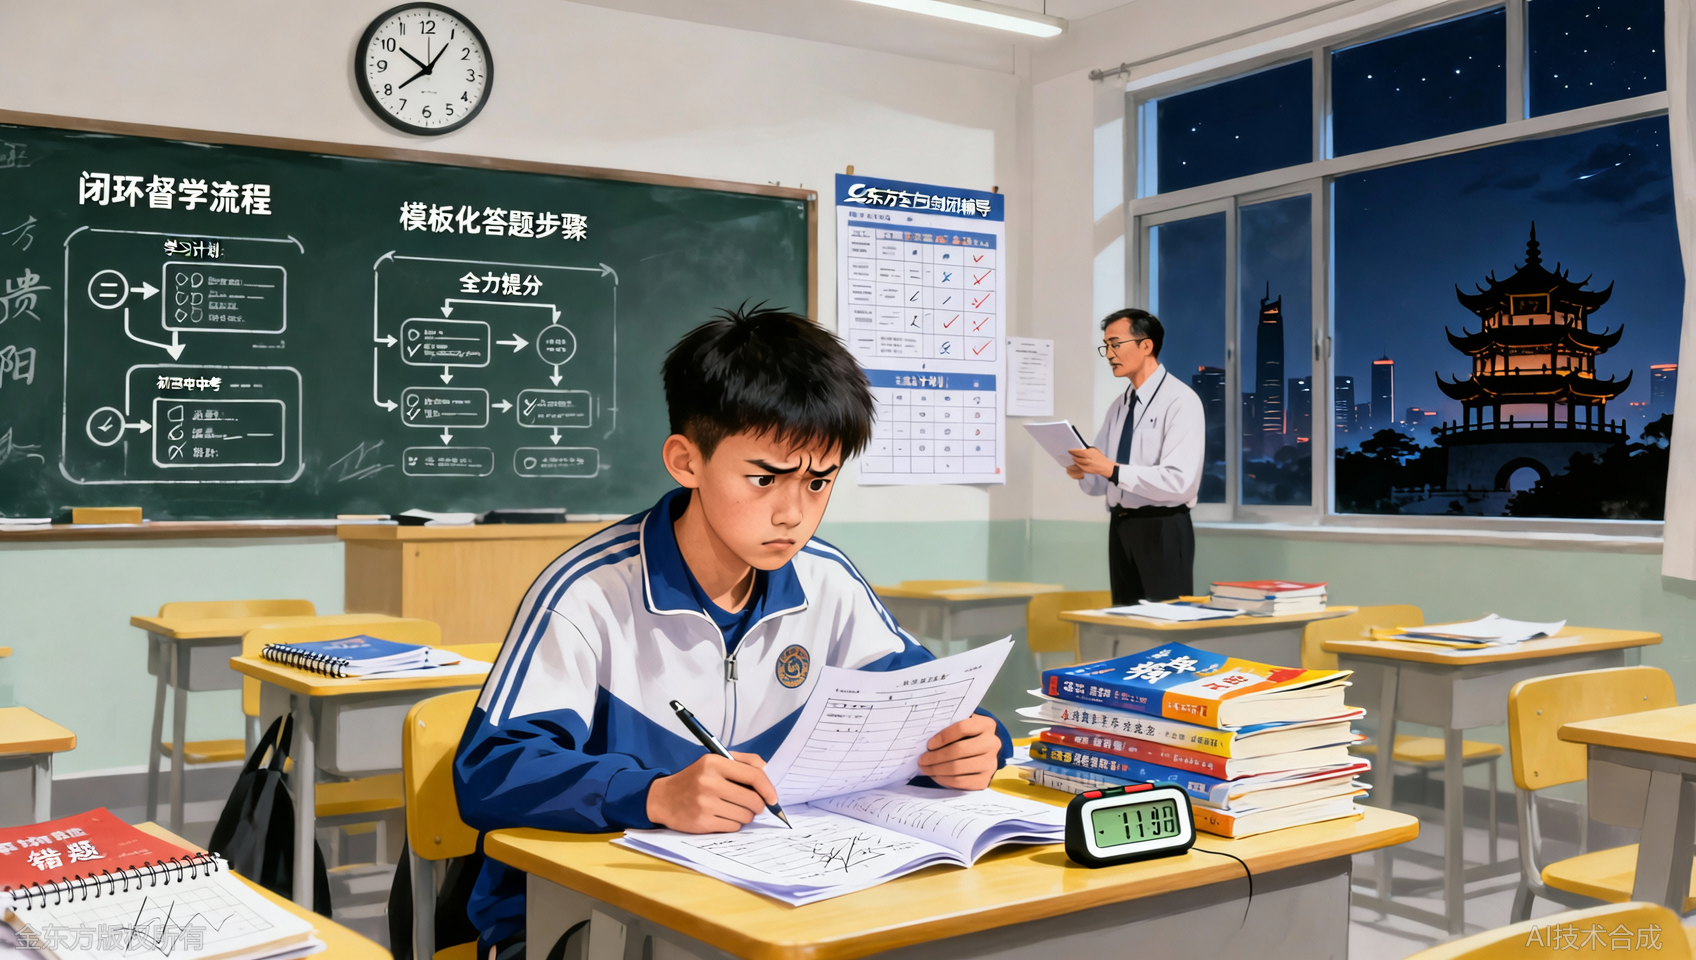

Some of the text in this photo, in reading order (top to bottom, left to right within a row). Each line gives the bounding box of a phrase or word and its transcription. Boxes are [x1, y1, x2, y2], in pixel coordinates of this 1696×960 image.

[419, 20, 436, 35] 12
[381, 37, 396, 53] 10
[460, 47, 471, 61] 2
[376, 59, 388, 73] 9
[466, 68, 476, 83] 3
[384, 83, 393, 97] 8
[460, 90, 469, 102] 4
[398, 98, 408, 111] 7
[445, 103, 454, 116] 5
[421, 105, 432, 119] 6
[78, 170, 273, 215] 闭环督学流程
[399, 201, 588, 242] 模板化答题步骤
[459, 271, 543, 297] 全力提分
